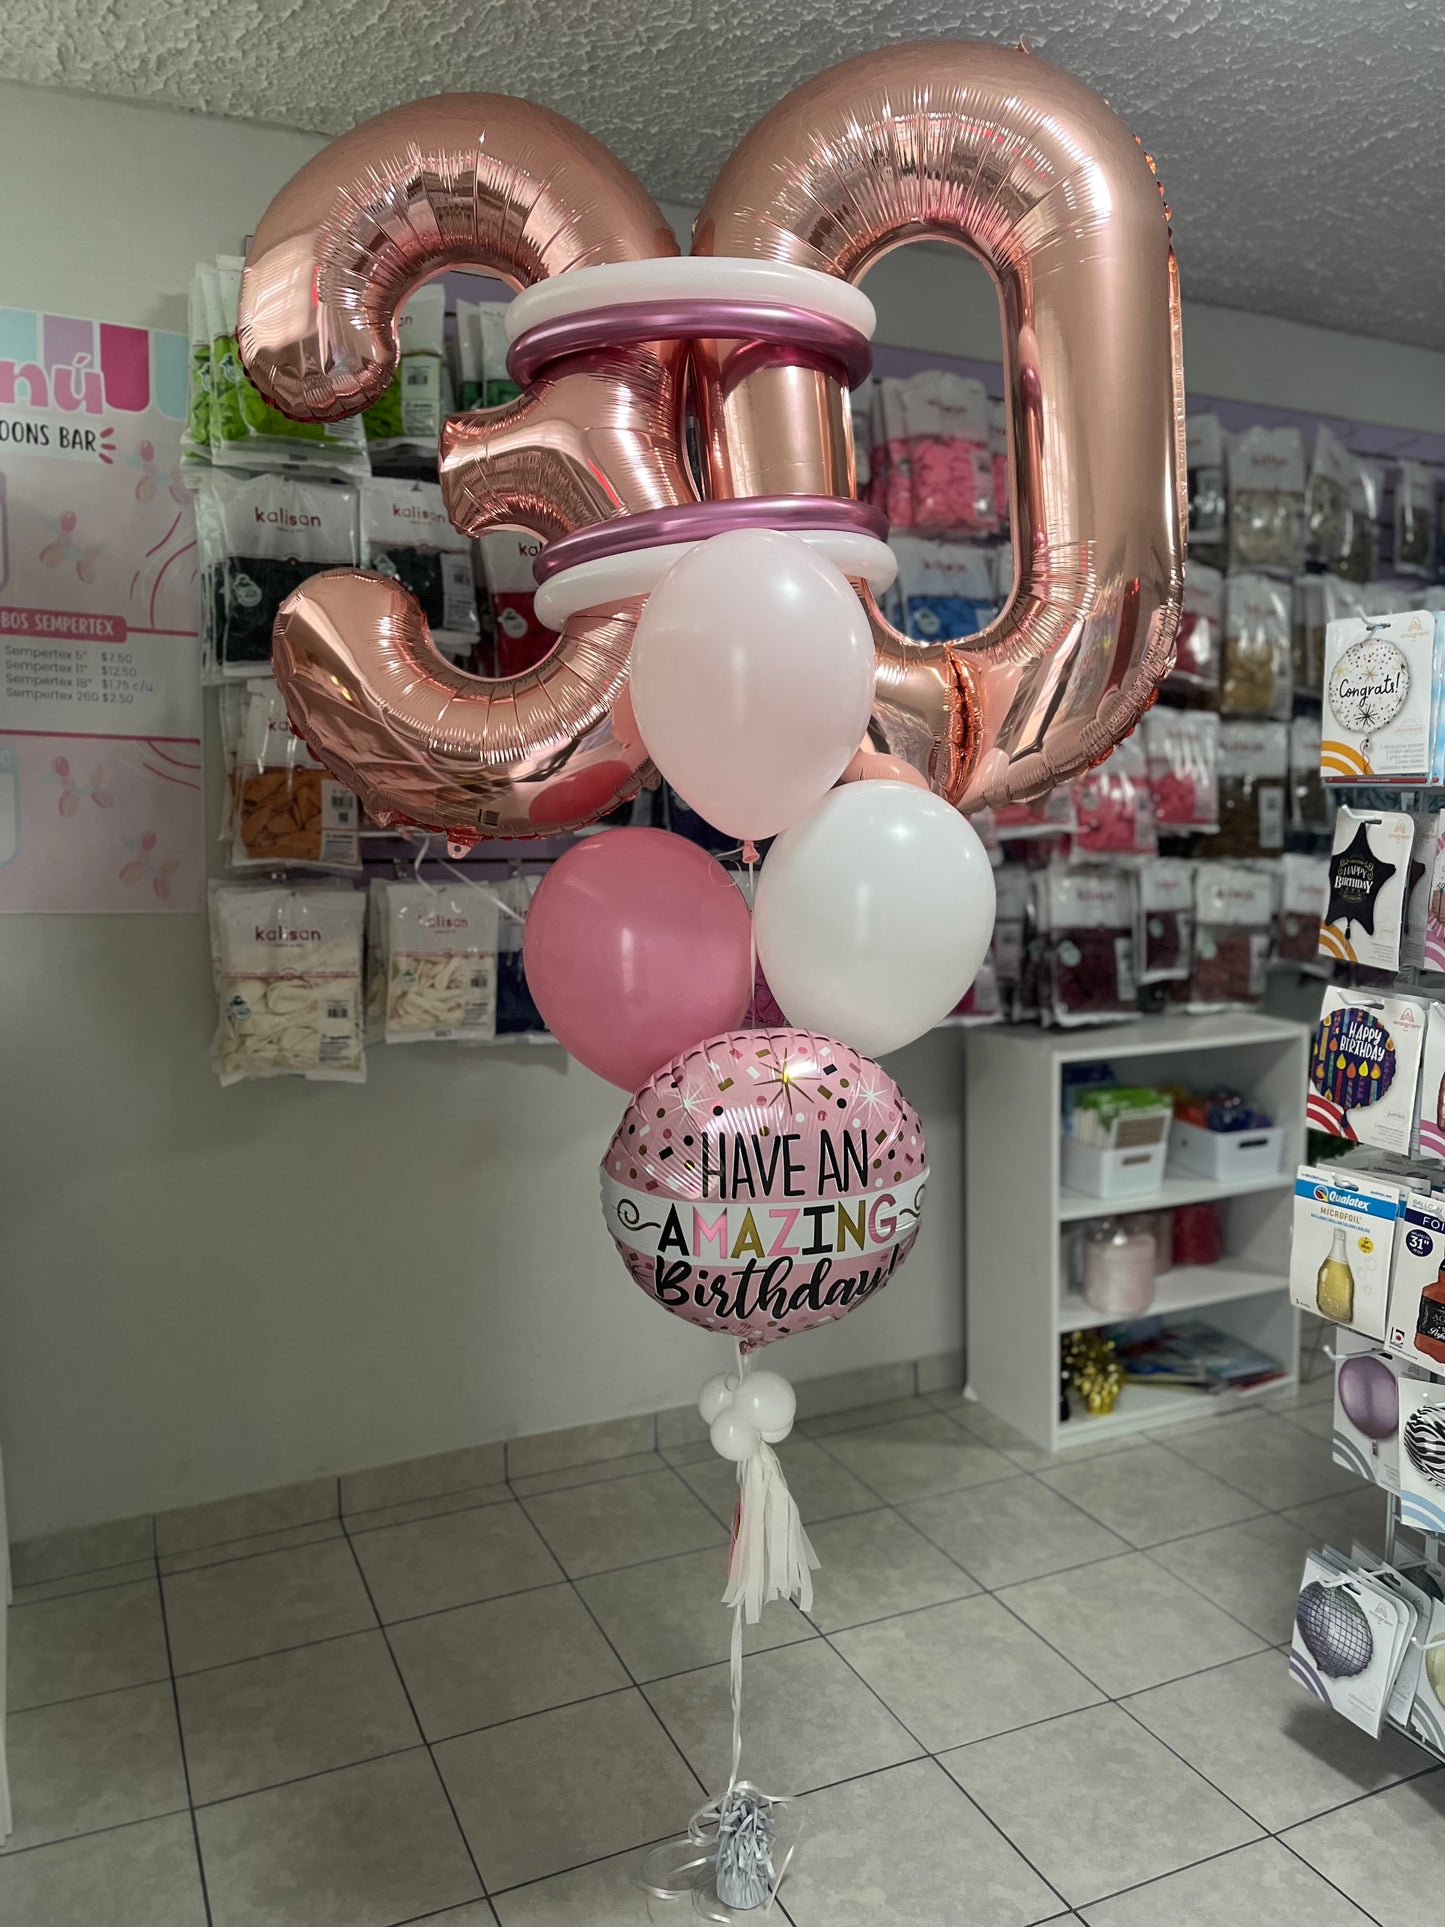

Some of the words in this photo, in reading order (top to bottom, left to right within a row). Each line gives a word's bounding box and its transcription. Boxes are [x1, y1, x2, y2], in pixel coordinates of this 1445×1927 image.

[59, 426, 96, 452] BAR
[255, 506, 321, 528] kalisan
[392, 504, 446, 524] kalisan
[34, 614, 114, 636] SEMPERTEX
[4, 645, 72, 661] Sempertex
[101, 651, 133, 664] $7.50
[5, 659, 72, 674] Sempertex
[101, 665, 137, 678] $12.50
[5, 673, 73, 688] Sempertex
[101, 679, 130, 691] $1.75
[1339, 672, 1401, 708] Congrats!
[6, 687, 73, 701] Sempertex
[102, 692, 134, 704] $2.50
[1343, 865, 1368, 879] HAPPY
[1334, 875, 1374, 894] BIRTHDAY
[255, 926, 321, 942] kalisan
[1348, 1021, 1382, 1046] HAPPY
[1340, 1035, 1386, 1062] BIRTHDAY
[701, 1131, 806, 1200] HAVE
[817, 1128, 869, 1196] AN
[1329, 1190, 1371, 1212] Qualatex
[656, 1193, 898, 1259] AMAZING
[1320, 1206, 1361, 1225] MICROFOIL
[1409, 1235, 1430, 1250] 31"
[654, 1243, 900, 1321] Birthday!
